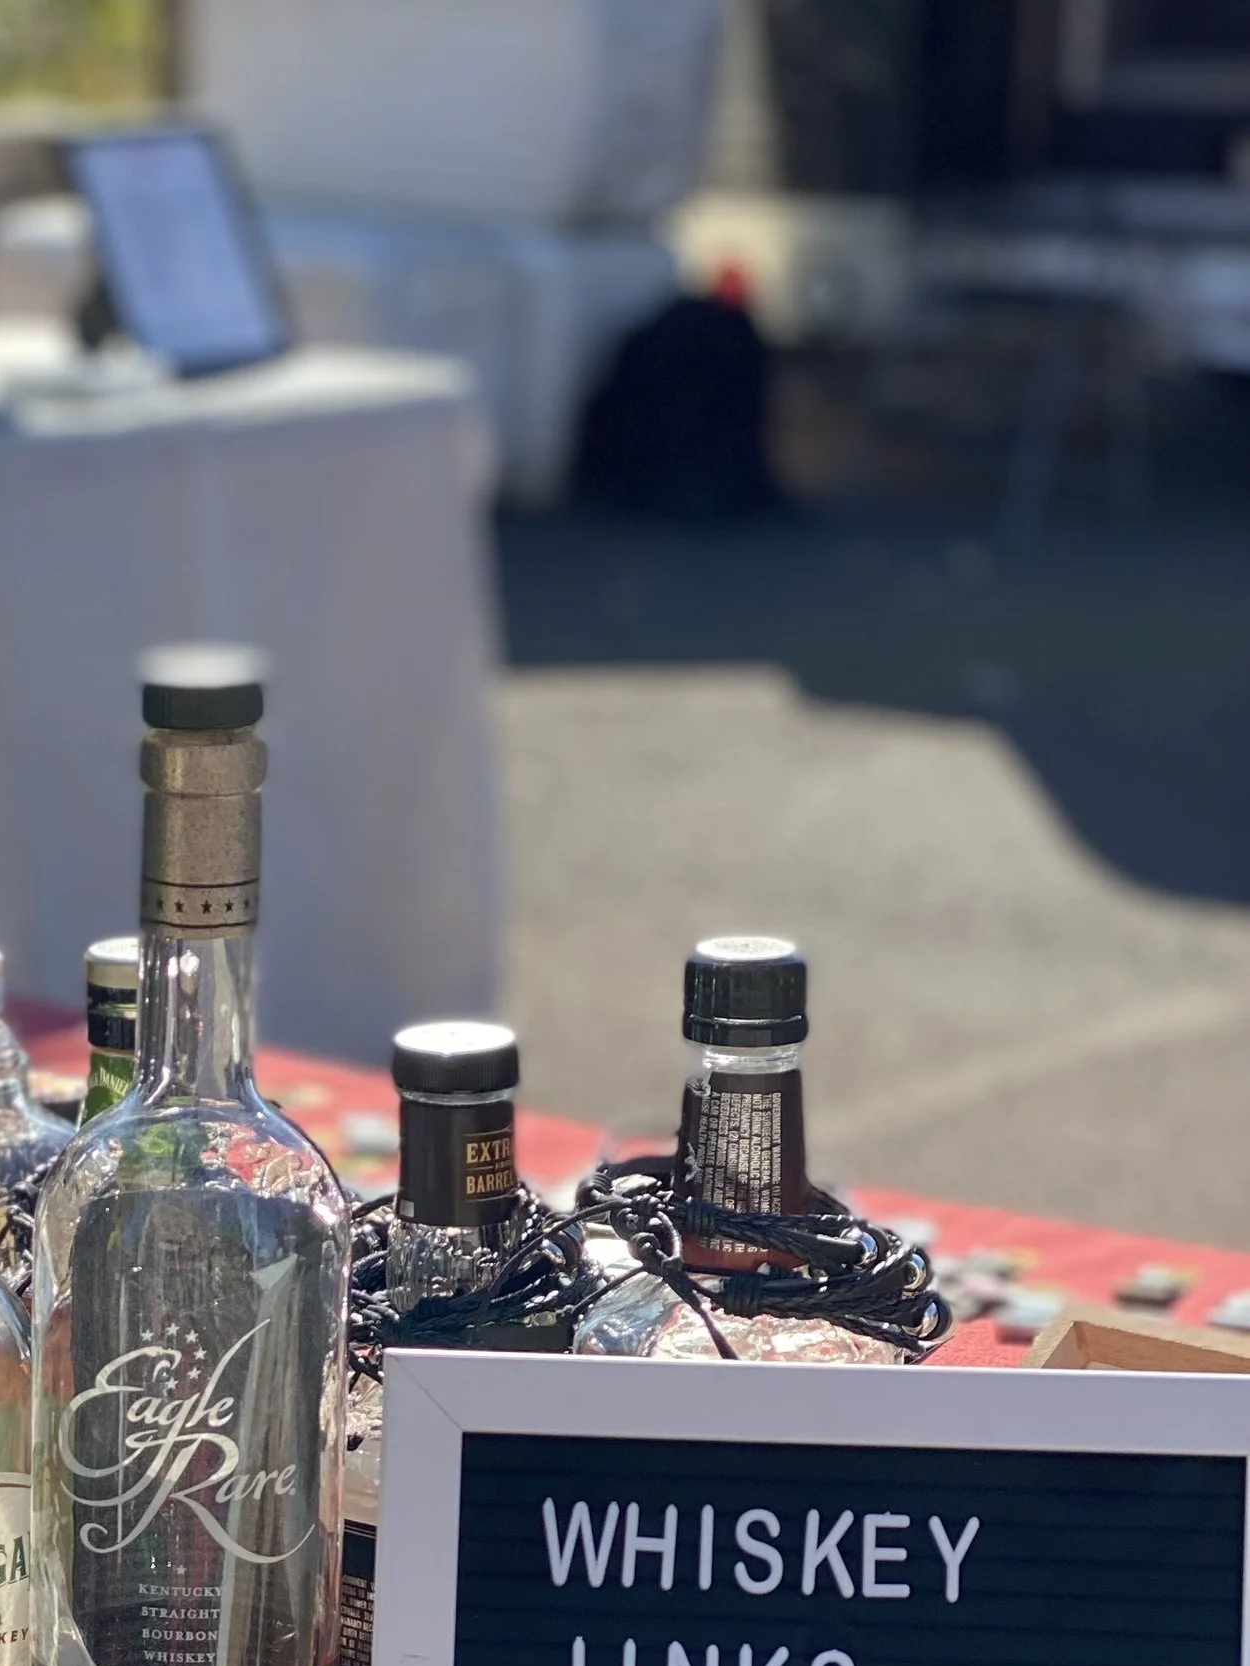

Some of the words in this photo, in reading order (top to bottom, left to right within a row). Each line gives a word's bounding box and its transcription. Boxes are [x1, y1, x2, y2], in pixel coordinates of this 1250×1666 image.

[465, 1138, 511, 1163] EXTR
[58, 1319, 271, 1477] Eagle
[542, 1496, 980, 1603] WHISKEY
[138, 1583, 224, 1598] KENTUCKY
[141, 1606, 221, 1621] STRAIGHT
[141, 1628, 218, 1642] BOURBON
[144, 1650, 217, 1664] WHISKEY
